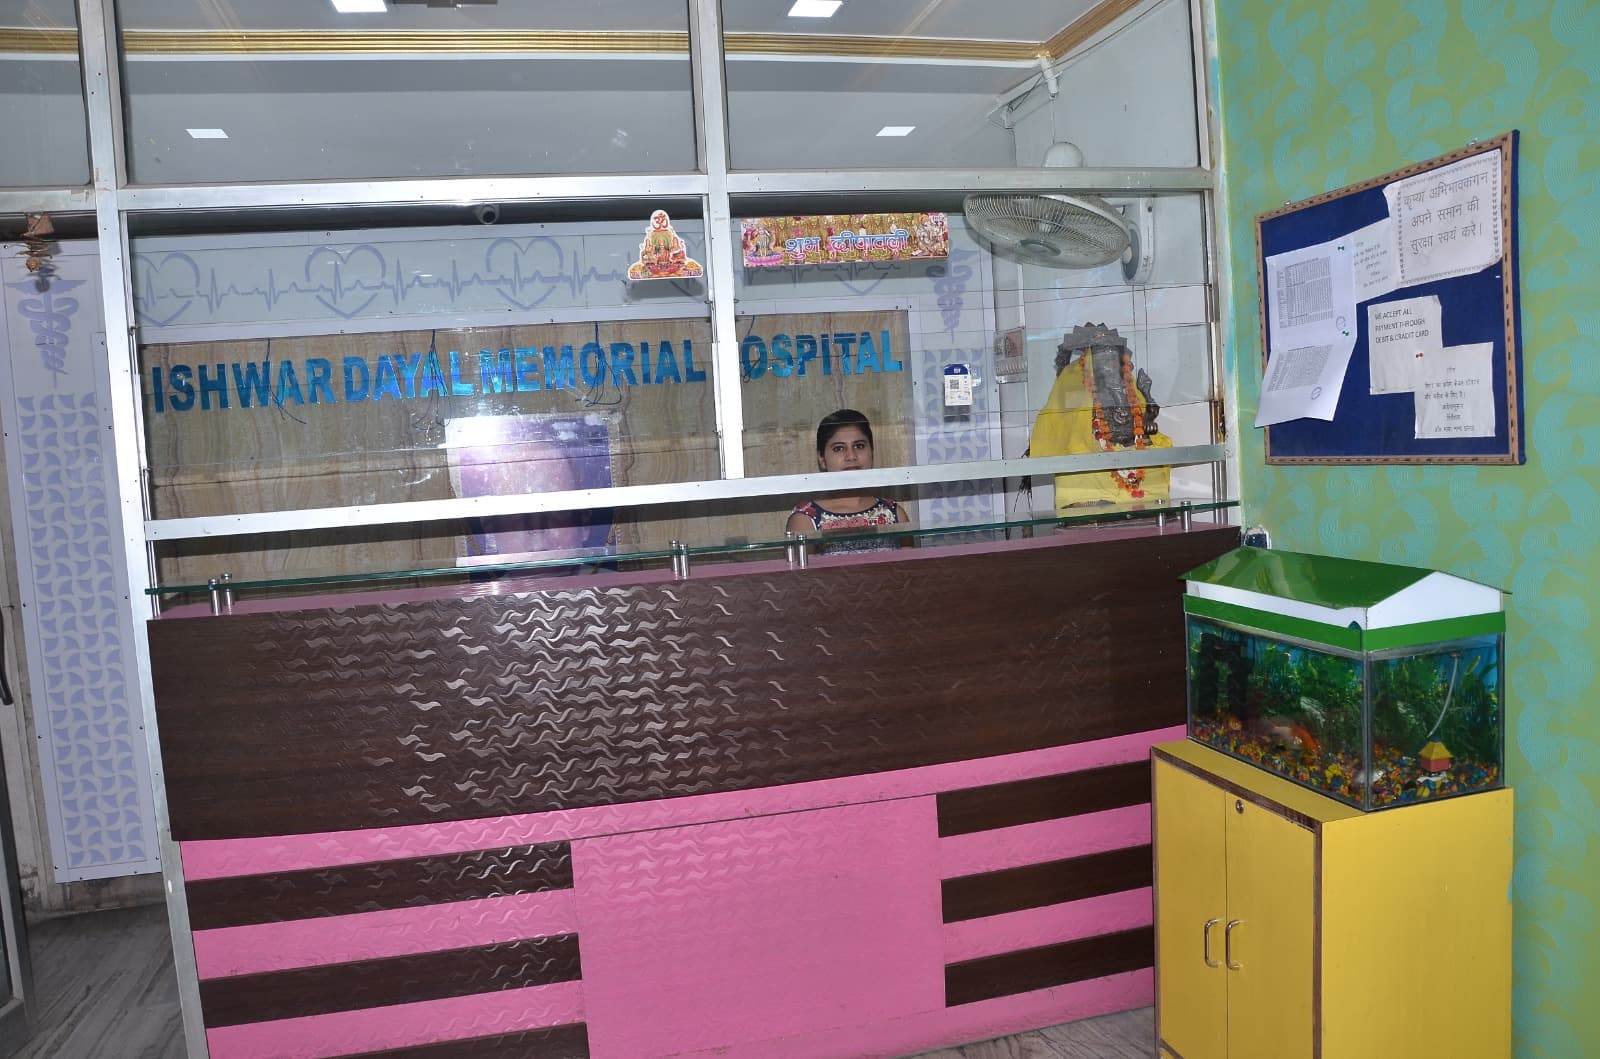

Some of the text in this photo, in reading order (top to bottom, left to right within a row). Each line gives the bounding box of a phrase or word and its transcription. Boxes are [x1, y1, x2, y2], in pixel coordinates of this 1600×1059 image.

[1411, 209, 1432, 227] अपने
[1466, 196, 1480, 212] की
[785, 229, 909, 260] शुभ दीपावली
[1410, 235, 1433, 255] सुरक्षा
[1438, 226, 1457, 243] स्वयं
[1375, 322, 1398, 331] PAYMENT
[1383, 309, 1402, 319] ACCEPT
[1403, 308, 1413, 316] ALL
[151, 330, 903, 413] ISHWAR DAYAL MEMORIAL OSPITAL
